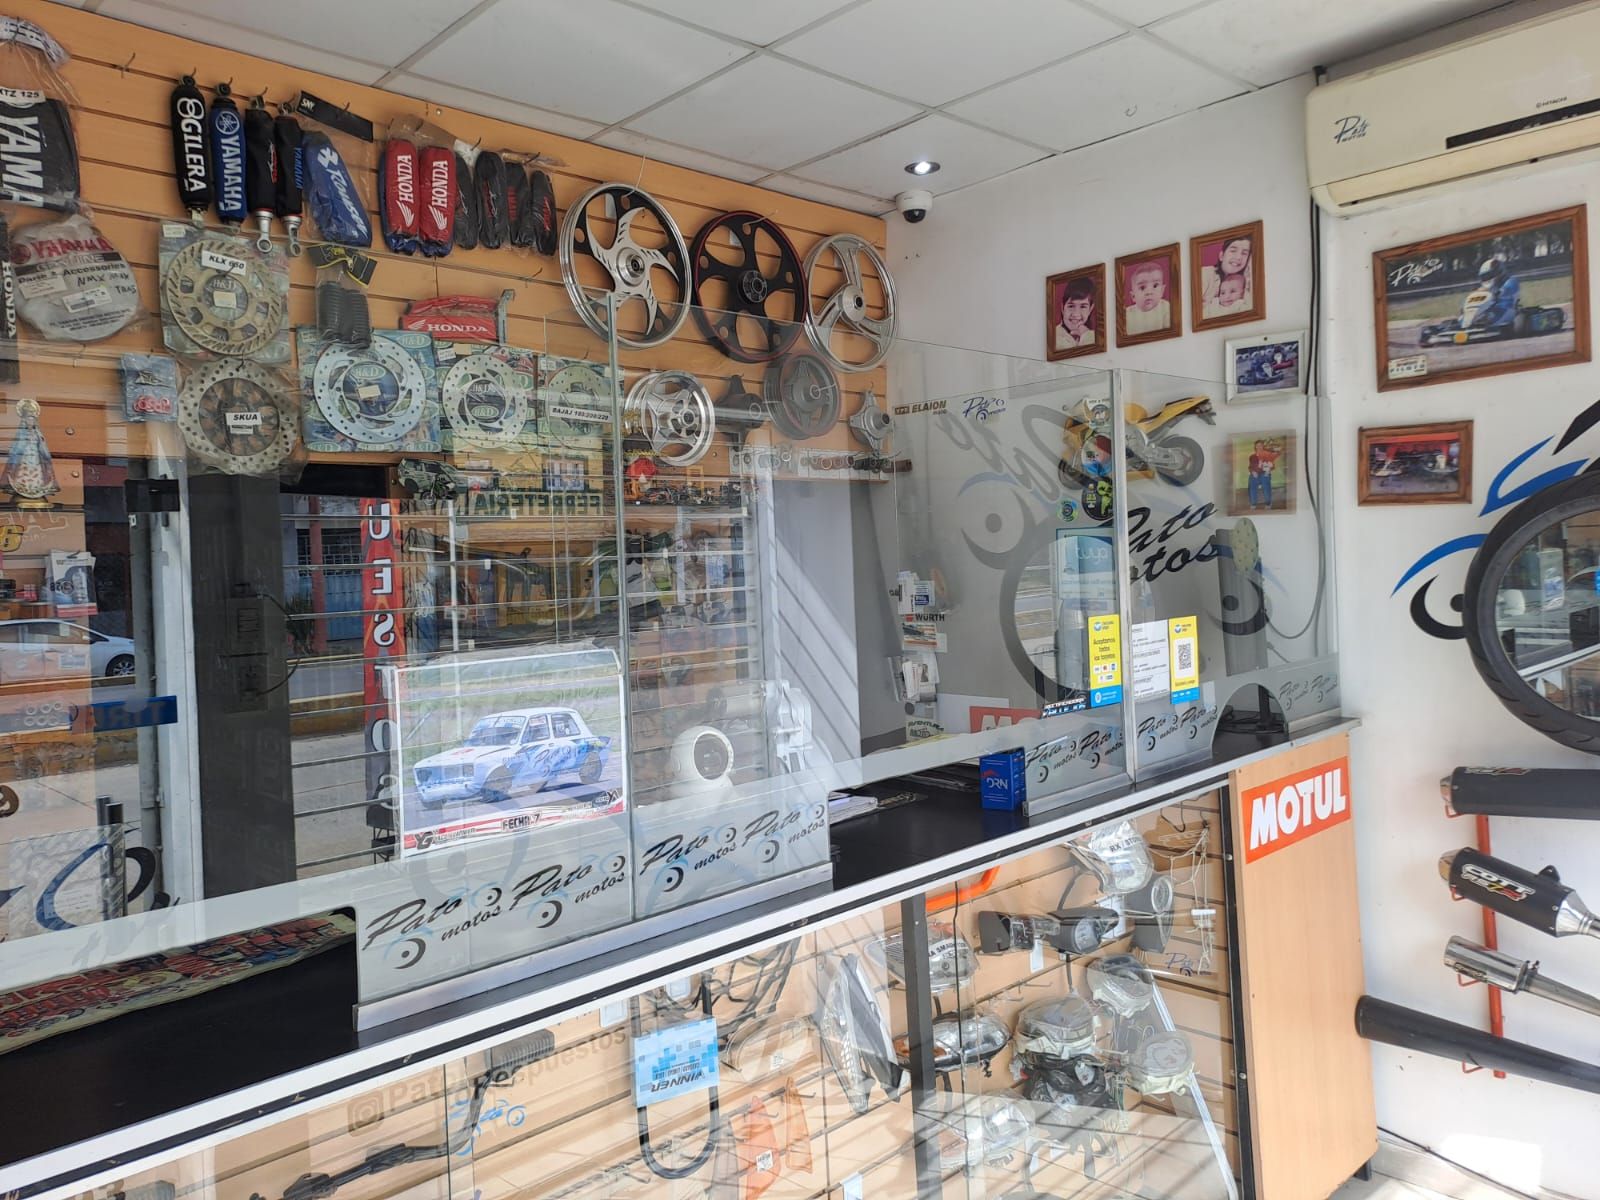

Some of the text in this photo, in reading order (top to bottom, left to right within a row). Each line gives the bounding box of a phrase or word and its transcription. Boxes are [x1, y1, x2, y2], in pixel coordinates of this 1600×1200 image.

[181, 117, 207, 192] GILERA
[221, 136, 243, 212] YAMAHA
[397, 154, 414, 203] HONDA
[431, 160, 449, 208] HONDA
[208, 255, 227, 265] KLX
[2, 261, 17, 339] HONDA
[427, 323, 489, 333] HONDA
[911, 399, 947, 414] ELAION
[1079, 730, 1111, 756] Pato
[1137, 716, 1167, 738] Pato
[1250, 768, 1346, 850] MOTUL
[742, 810, 801, 847] Pato
[788, 819, 825, 844] motos
[640, 834, 709, 876] Pato
[694, 842, 738, 871] motos
[508, 864, 593, 911] Pato
[574, 871, 625, 904] motos
[362, 898, 463, 951] Pato
[441, 905, 502, 941] motos
[650, 1070, 705, 1093] WINNER
